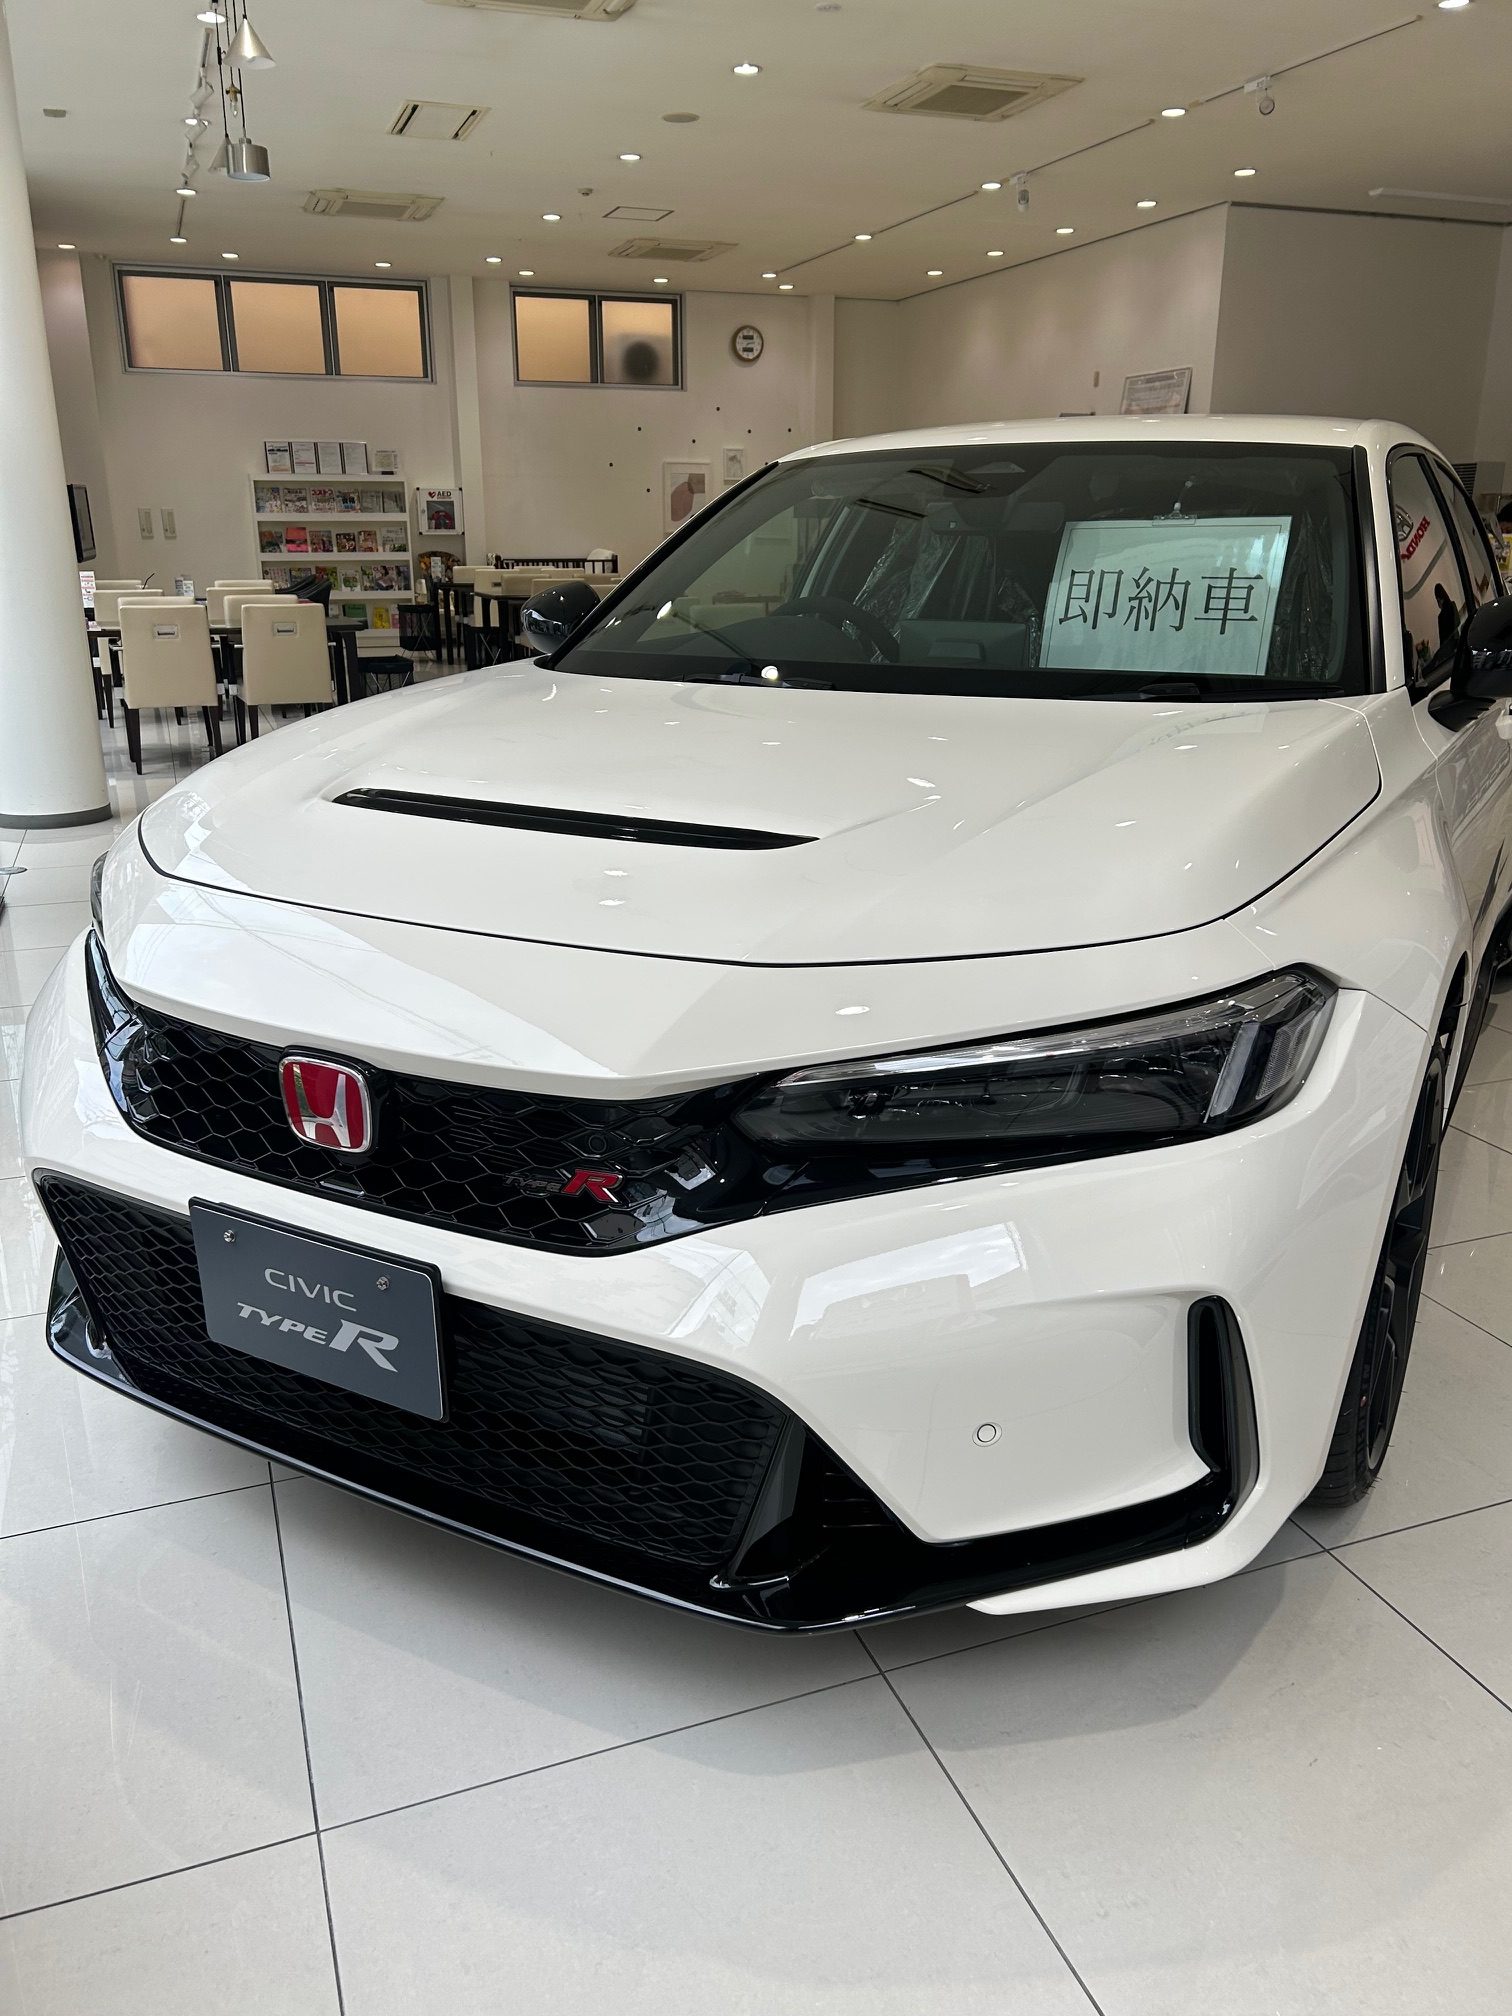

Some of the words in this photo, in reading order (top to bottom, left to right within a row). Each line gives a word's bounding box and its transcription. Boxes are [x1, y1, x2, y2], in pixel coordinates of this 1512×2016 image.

[1058, 566, 1263, 635] 即納車
[264, 1268, 357, 1312] CIVIC
